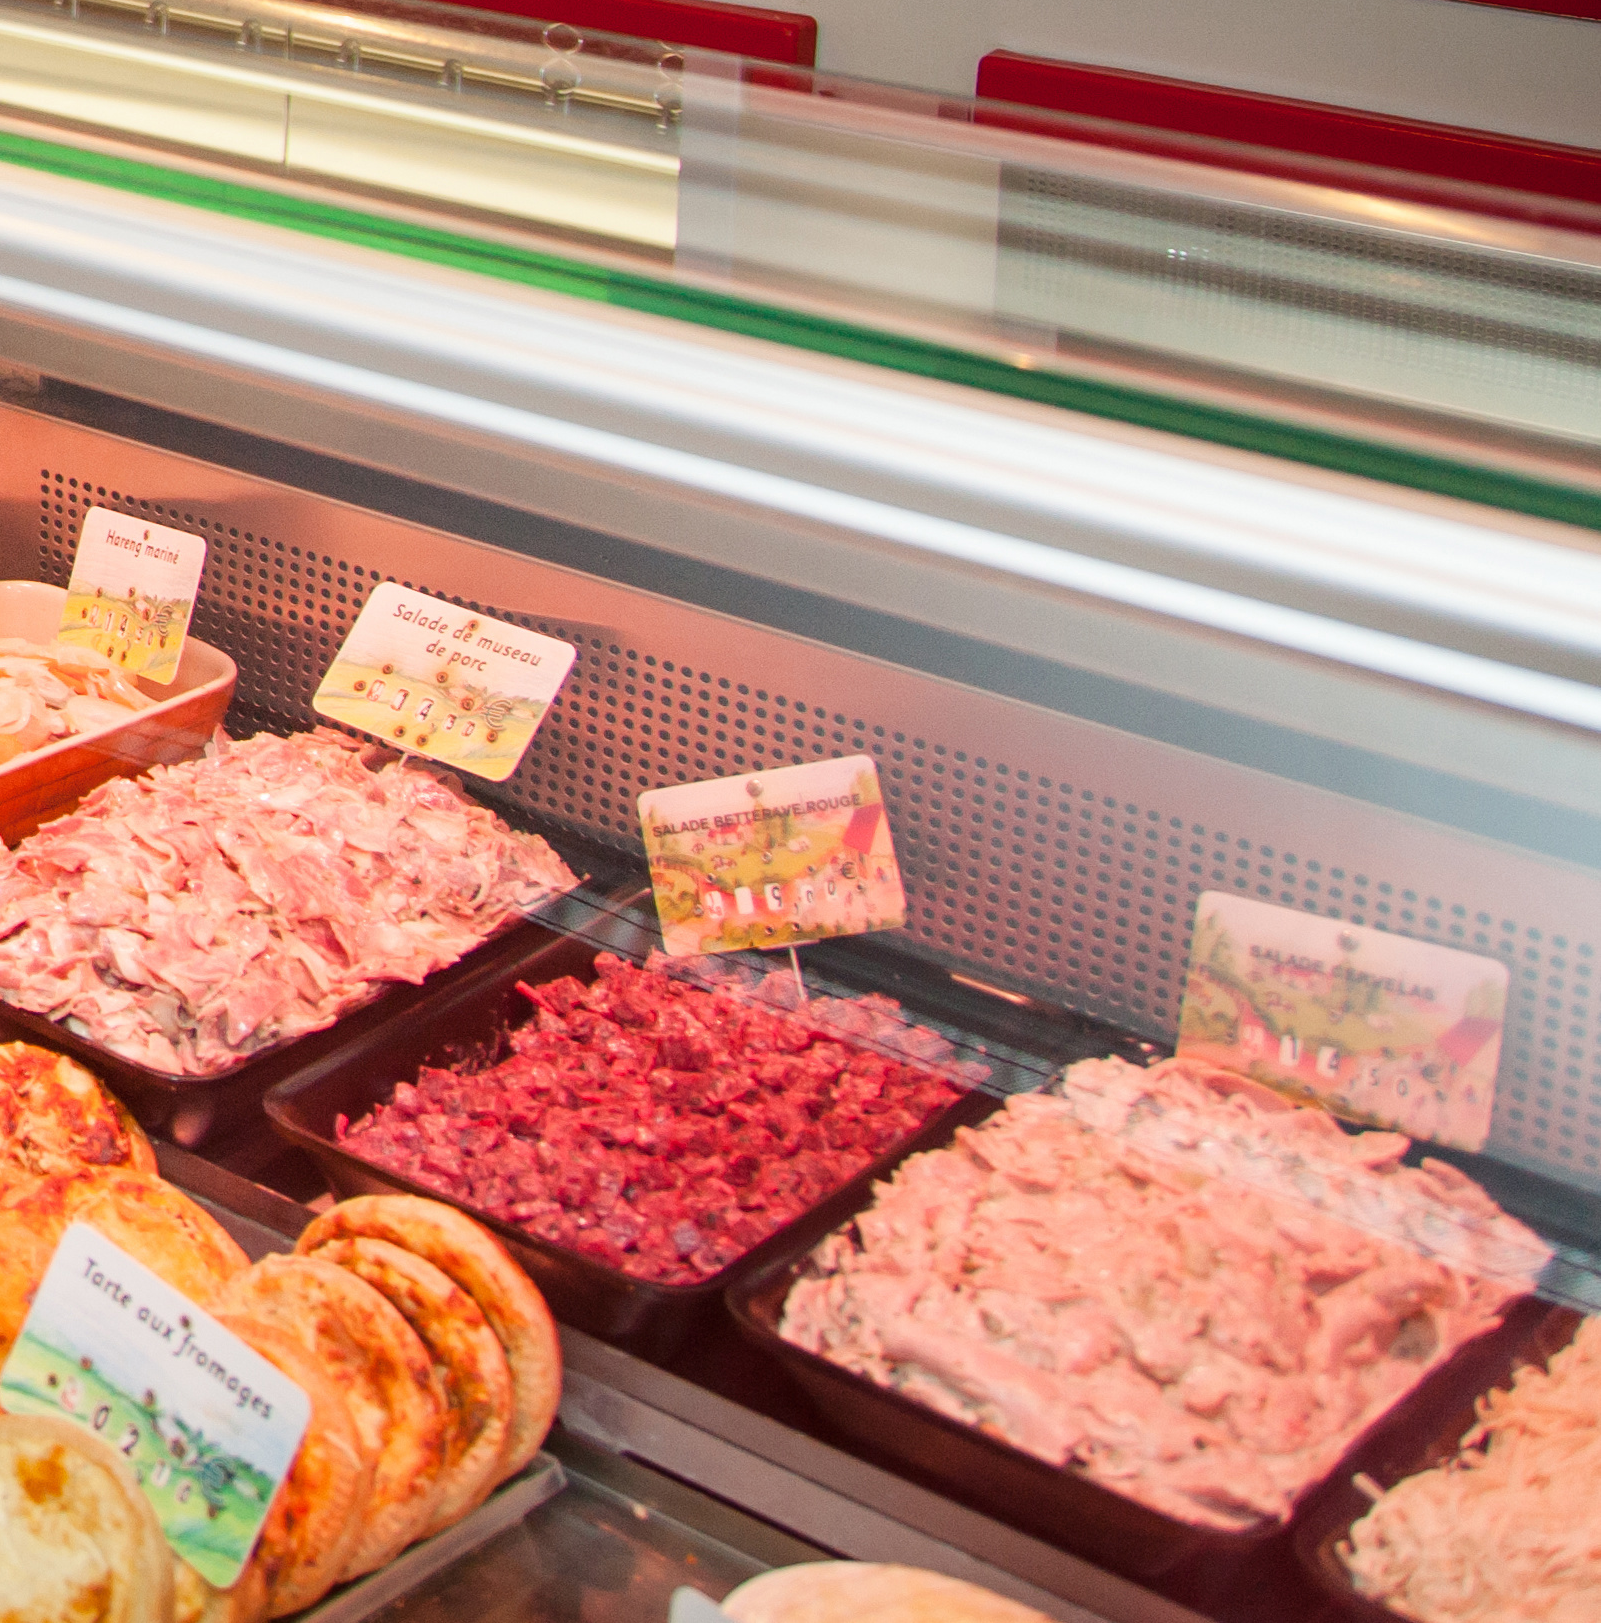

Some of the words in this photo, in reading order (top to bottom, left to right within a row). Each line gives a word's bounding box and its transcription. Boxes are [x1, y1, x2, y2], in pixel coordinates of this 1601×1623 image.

[105, 529, 142, 557] Hareng
[144, 538, 180, 565] mariné
[393, 603, 448, 639] Salade
[451, 623, 473, 643] de
[477, 632, 542, 668] museau
[426, 638, 447, 658] de
[451, 649, 488, 673] porc
[652, 817, 709, 838] SALADE
[714, 804, 806, 827] BETTERAVE
[806, 793, 861, 812] ROUGE
[1250, 944, 1323, 974] SALADE
[82, 1258, 132, 1308] Tarte
[137, 1305, 174, 1342] aux
[173, 1333, 274, 1420] fromages
